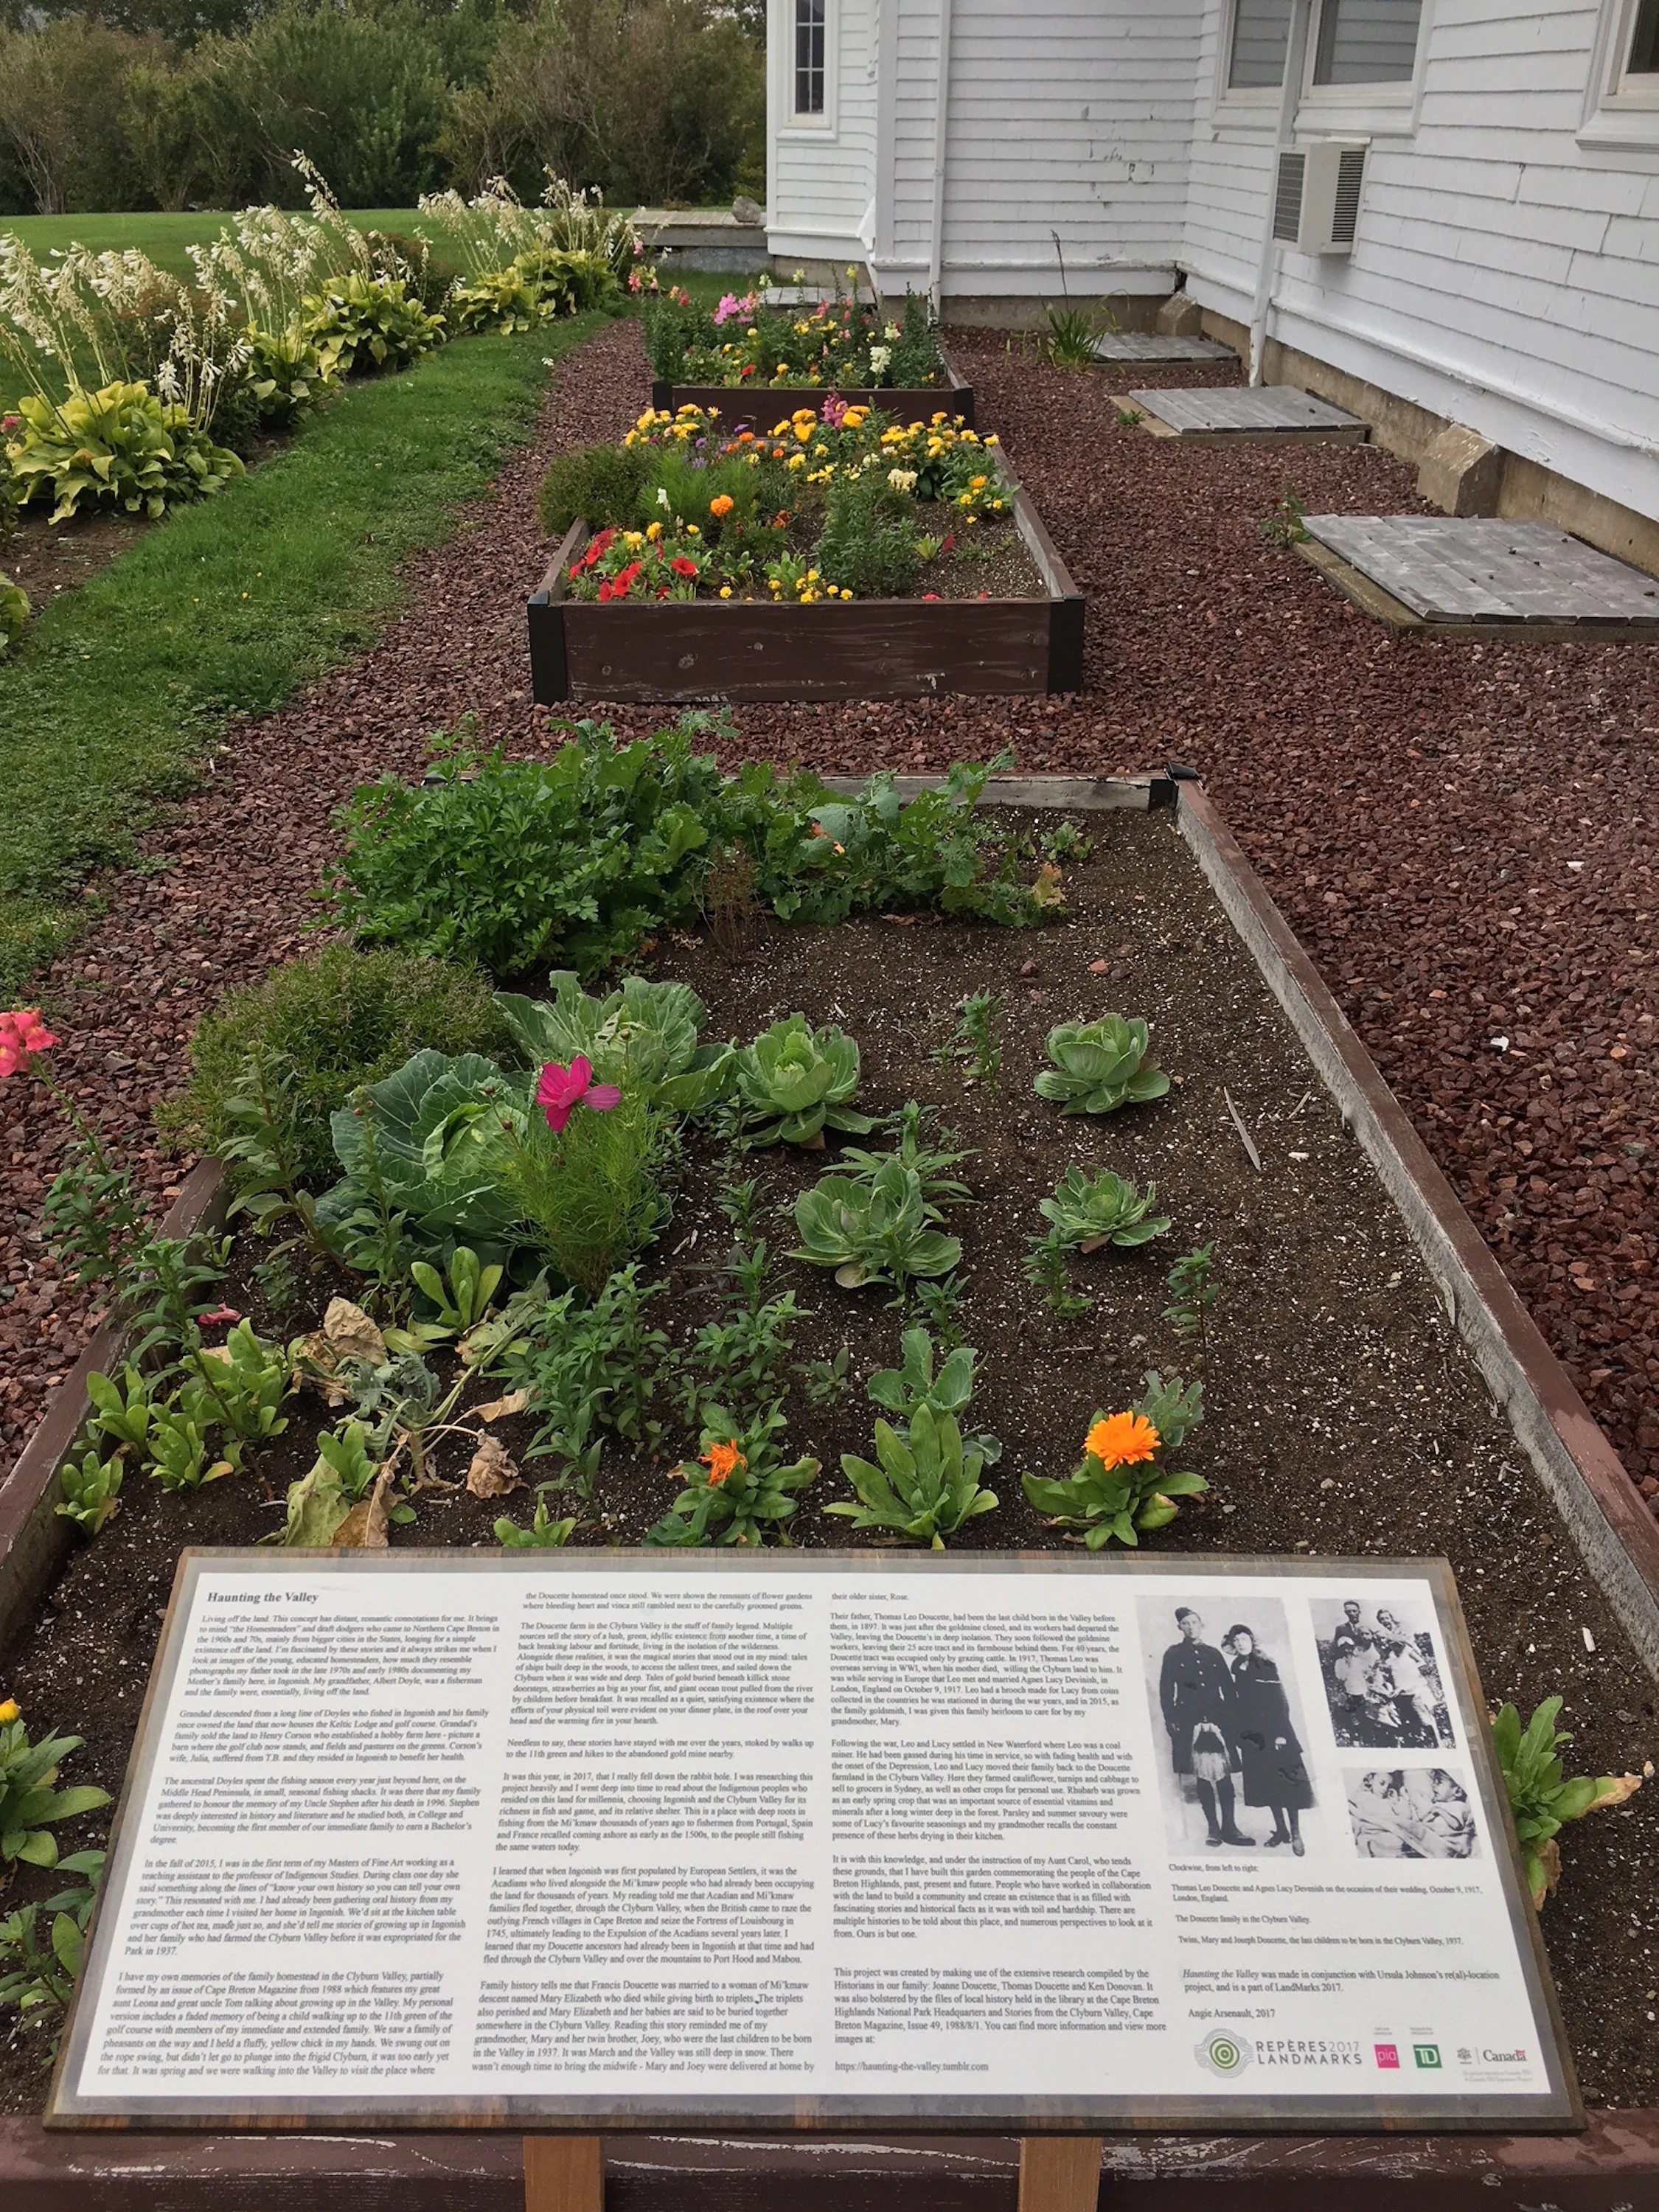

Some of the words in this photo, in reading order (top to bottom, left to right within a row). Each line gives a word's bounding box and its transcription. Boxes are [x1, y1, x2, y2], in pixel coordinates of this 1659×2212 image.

[206, 1593, 262, 1604] Haunting
[263, 1593, 282, 1601] the
[283, 1592, 319, 1604] Valley
[201, 1615, 226, 1624] Living
[475, 1615, 498, 1623] brings
[546, 1751, 568, 1759] green
[628, 1749, 668, 1757] abandoned
[669, 1750, 686, 1759] gold
[1220, 1915, 1241, 1924] family
[1261, 1915, 1288, 1924] Clyburn
[833, 1928, 855, 1938] from.
[856, 1929, 875, 1938] Ours
[886, 1929, 899, 1938] but
[124, 1946, 144, 1954] Park
[156, 1944, 181, 1955] 1937.
[483, 1954, 499, 1963] fled
[500, 1954, 532, 1965] through
[533, 1953, 547, 1963] the
[547, 1954, 581, 1965] Clyburn
[582, 1954, 608, 1965] Valley
[609, 1954, 625, 1963] and
[645, 1954, 658, 1963] the
[660, 1953, 701, 1963] mountains
[713, 1954, 730, 1963] Port
[731, 1954, 754, 1963] Hood
[755, 1955, 771, 1963] and
[772, 1954, 802, 1963] Mabou.
[1182, 1969, 1220, 1980] Haunting
[1220, 1969, 1234, 1978] the
[1235, 1969, 1259, 1980] Valley
[1277, 1969, 1300, 1978] made
[1310, 1969, 1357, 1980] conjunction
[1357, 1970, 1376, 1978] with
[1377, 1970, 1404, 1978] Ursula
[1404, 1970, 1444, 1979] Johnson's
[115, 1985, 146, 1994] formed
[203, 1985, 227, 1996] Cape
[227, 1985, 257, 1994] Breton
[257, 1983, 299, 1996] Magazine
[299, 1985, 320, 1994] from
[321, 1985, 343, 1994] 1988
[343, 1983, 369, 1994] which
[370, 1983, 403, 1993] features
[419, 1983, 441, 1995] great
[1184, 1983, 1214, 1993] project,
[1215, 1981, 1231, 1991] and
[1247, 1981, 1264, 1993] part
[1274, 1983, 1321, 1992] LandMarks
[1321, 1981, 1343, 1992] 2017.
[834, 2007, 875, 2018] Highlands
[877, 2007, 911, 2016] National
[913, 2006, 931, 2016] Park
[933, 2007, 987, 2018] Headquarters
[988, 2008, 1003, 2016] and
[1004, 2006, 1032, 2017] Stories
[1034, 2007, 1054, 2017] from
[1055, 2008, 1068, 2017] the
[1069, 2006, 1102, 2019] Clyburn
[1103, 2007, 1131, 2019] Valley,
[1132, 2008, 1153, 2019] Cape
[1188, 2008, 1212, 2020] Angie
[1213, 2008, 1254, 2018] Arsenault,
[1255, 2008, 1276, 2017] 2017
[835, 2020, 861, 2029] Breton
[863, 2020, 905, 2031] Magazine,
[907, 2021, 928, 2030] Issue
[930, 2021, 942, 2031] 49,
[945, 2020, 982, 2029] 1988/8/1.
[984, 2021, 1001, 2030] You
[1018, 2020, 1034, 2030] find
[1059, 2020, 1107, 2030] information
[1107, 2022, 1123, 2030] and
[1124, 2020, 1144, 2030] view
[835, 2034, 863, 2045] images
[1257, 2053, 1363, 2065] LANDMARKS
[1415, 2048, 1438, 2065] TD
[1483, 2049, 1527, 2062] Canada
